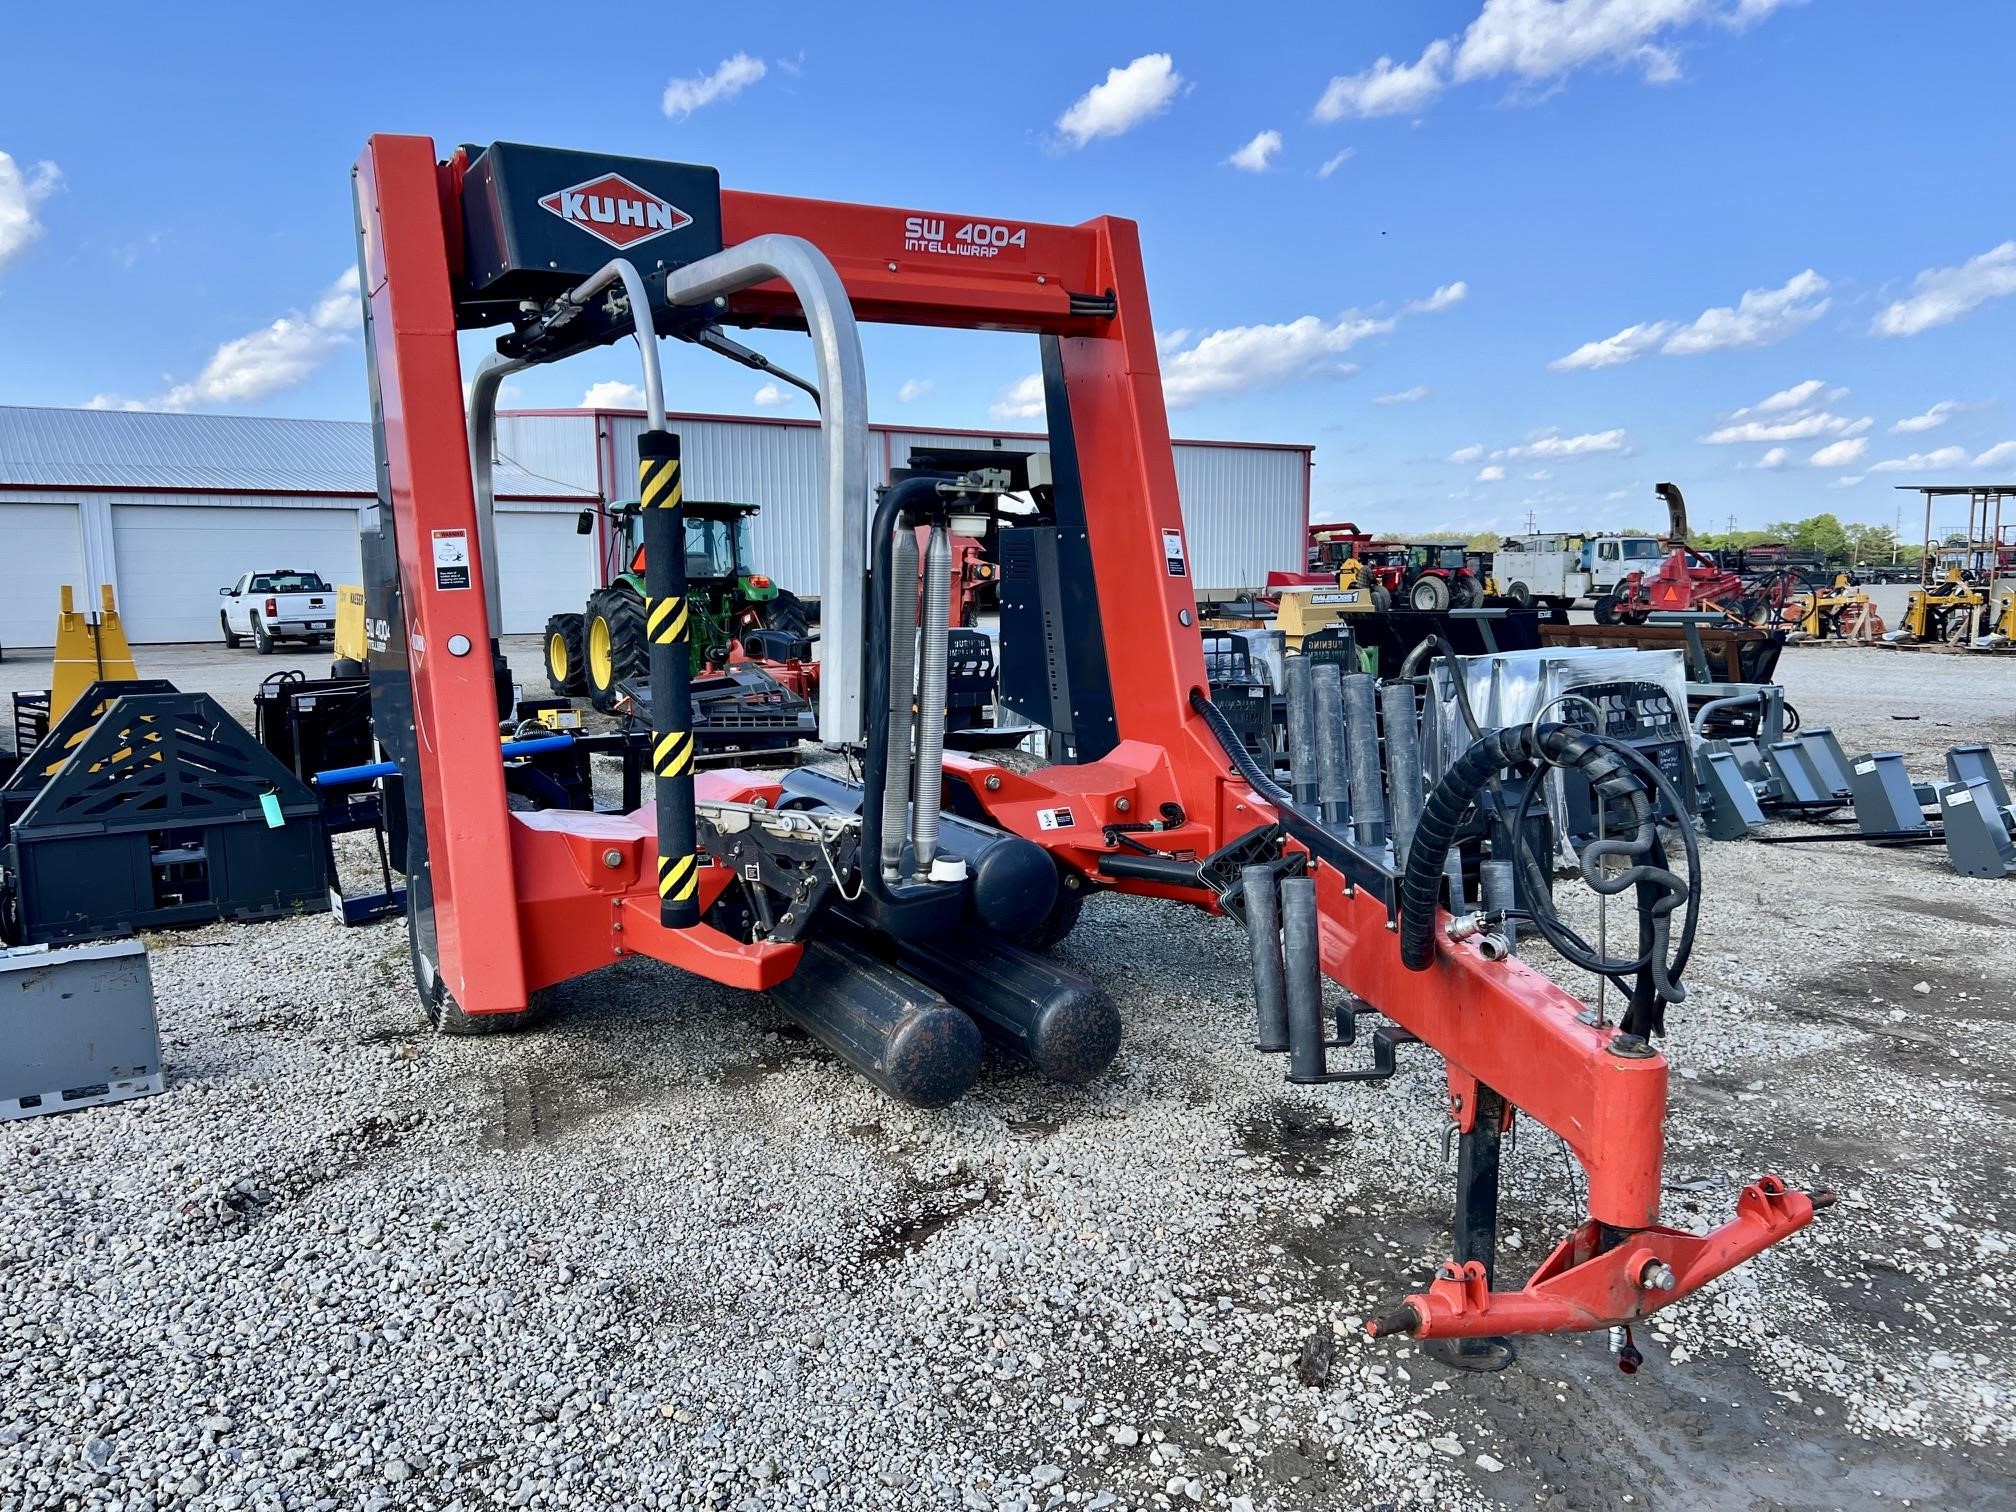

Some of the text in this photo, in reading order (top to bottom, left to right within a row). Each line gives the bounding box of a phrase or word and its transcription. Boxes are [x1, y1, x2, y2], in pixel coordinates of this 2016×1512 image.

[560, 191, 673, 230] KUHN
[905, 217, 1026, 249] SW 4004
[905, 238, 998, 258] INTELLIWRAP
